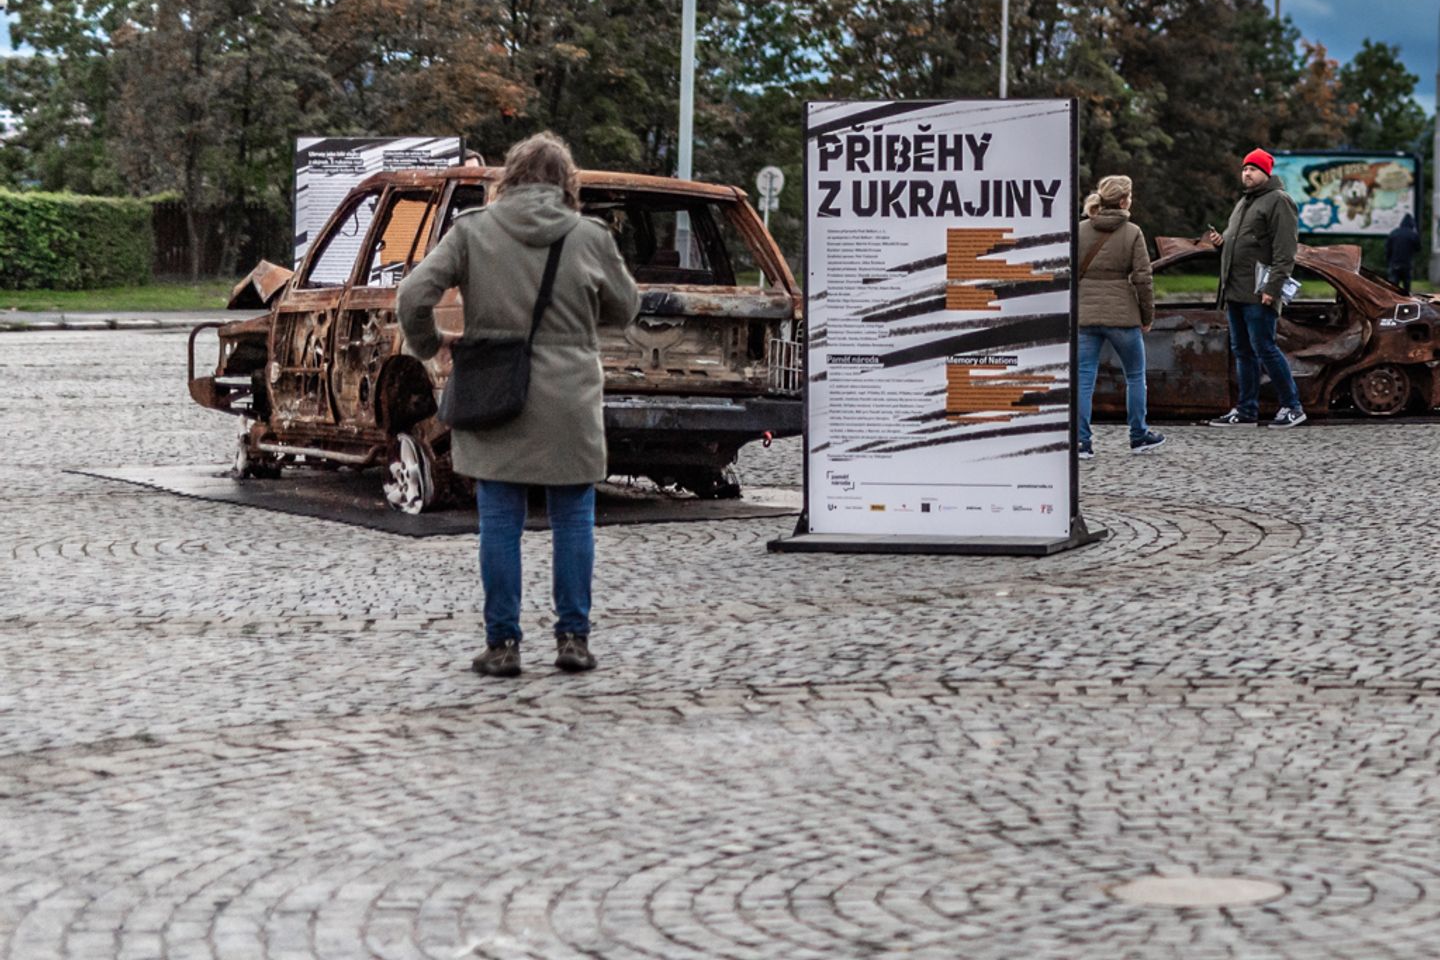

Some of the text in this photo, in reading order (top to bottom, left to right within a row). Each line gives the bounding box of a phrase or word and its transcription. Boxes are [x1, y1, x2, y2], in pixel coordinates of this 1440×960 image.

[817, 124, 992, 173] PŘÍBĚHY
[817, 179, 1062, 219] Z UKRAJINY
[947, 356, 1018, 366] Memory of Nations
